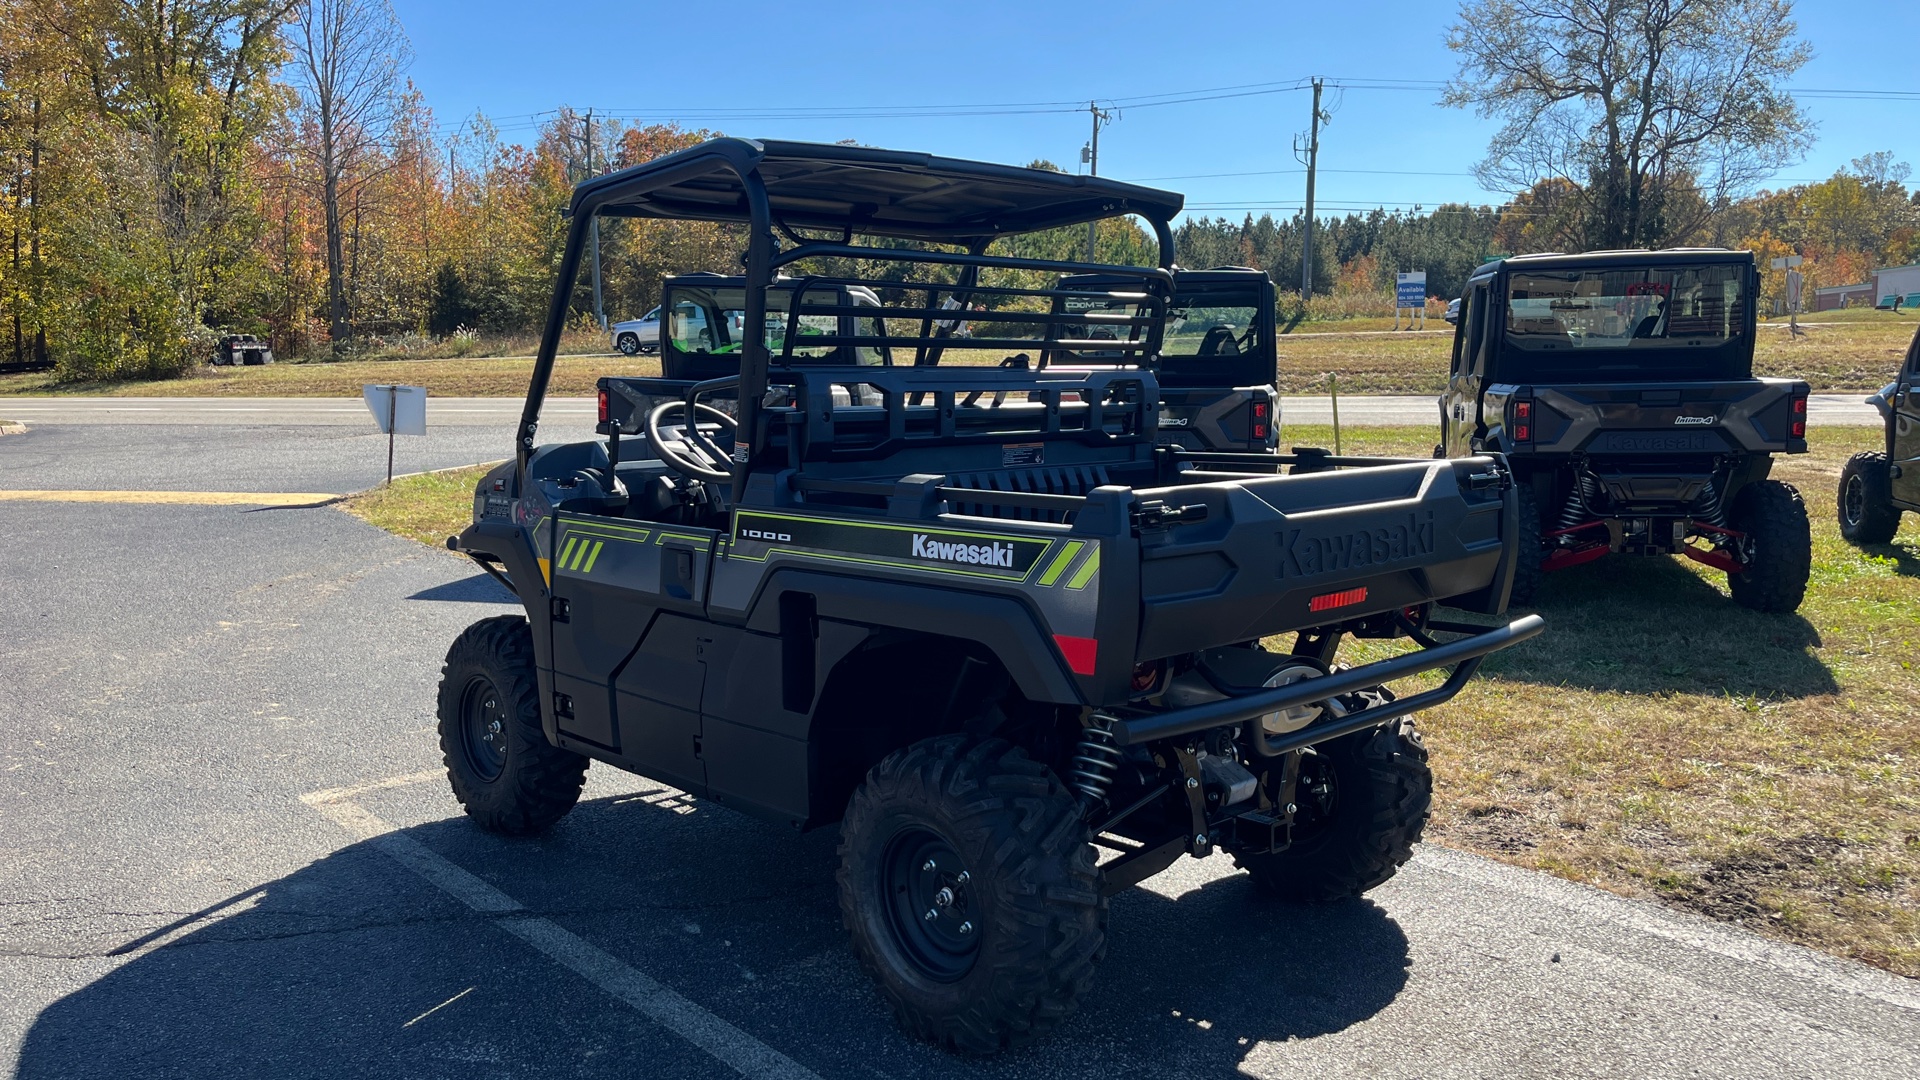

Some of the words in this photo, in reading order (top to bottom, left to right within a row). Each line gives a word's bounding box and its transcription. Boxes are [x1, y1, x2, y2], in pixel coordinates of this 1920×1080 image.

[1606, 432, 1710, 451] Kawasaki
[741, 528, 792, 542] 1000
[1274, 509, 1435, 580] Kawasaki
[911, 533, 1014, 568] Kawasaki
